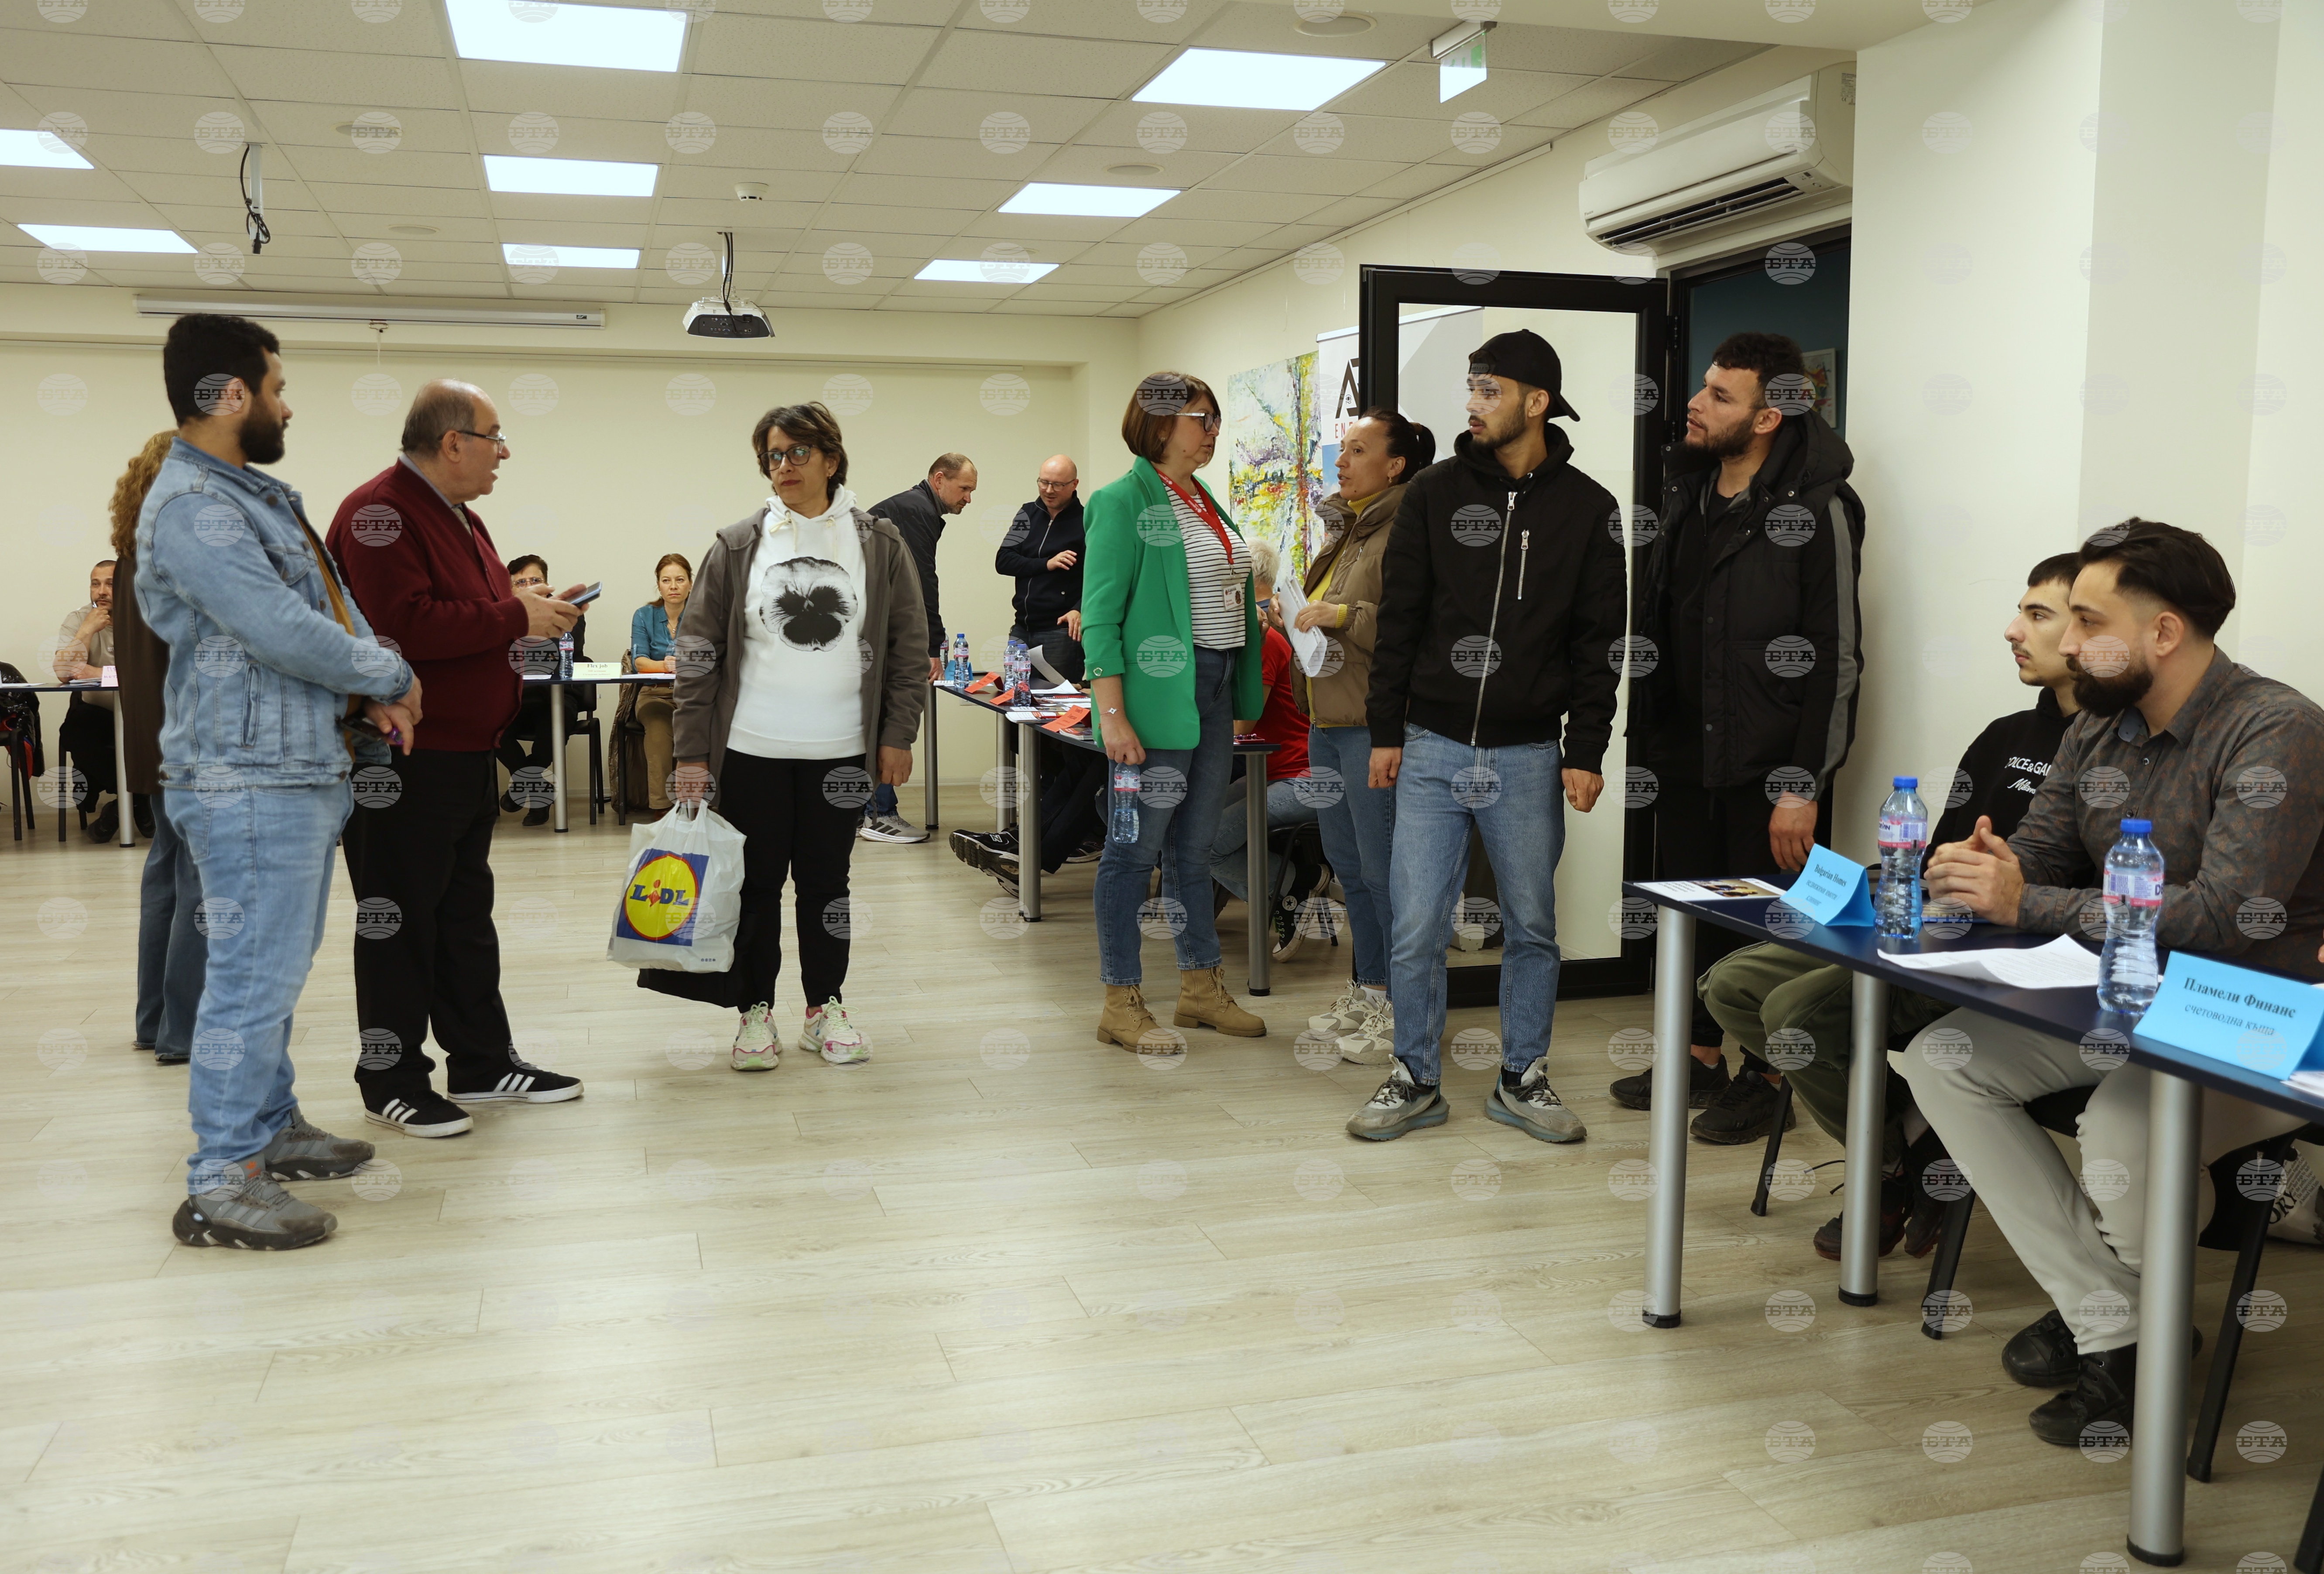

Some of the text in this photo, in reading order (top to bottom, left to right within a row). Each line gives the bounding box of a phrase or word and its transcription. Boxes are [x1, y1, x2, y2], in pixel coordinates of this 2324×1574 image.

[1814, 864, 1847, 887] Bulgarian Homes
[2183, 977, 2297, 1018] Пламели Финанс
[2185, 1004, 2275, 1036] счетоводна къща
